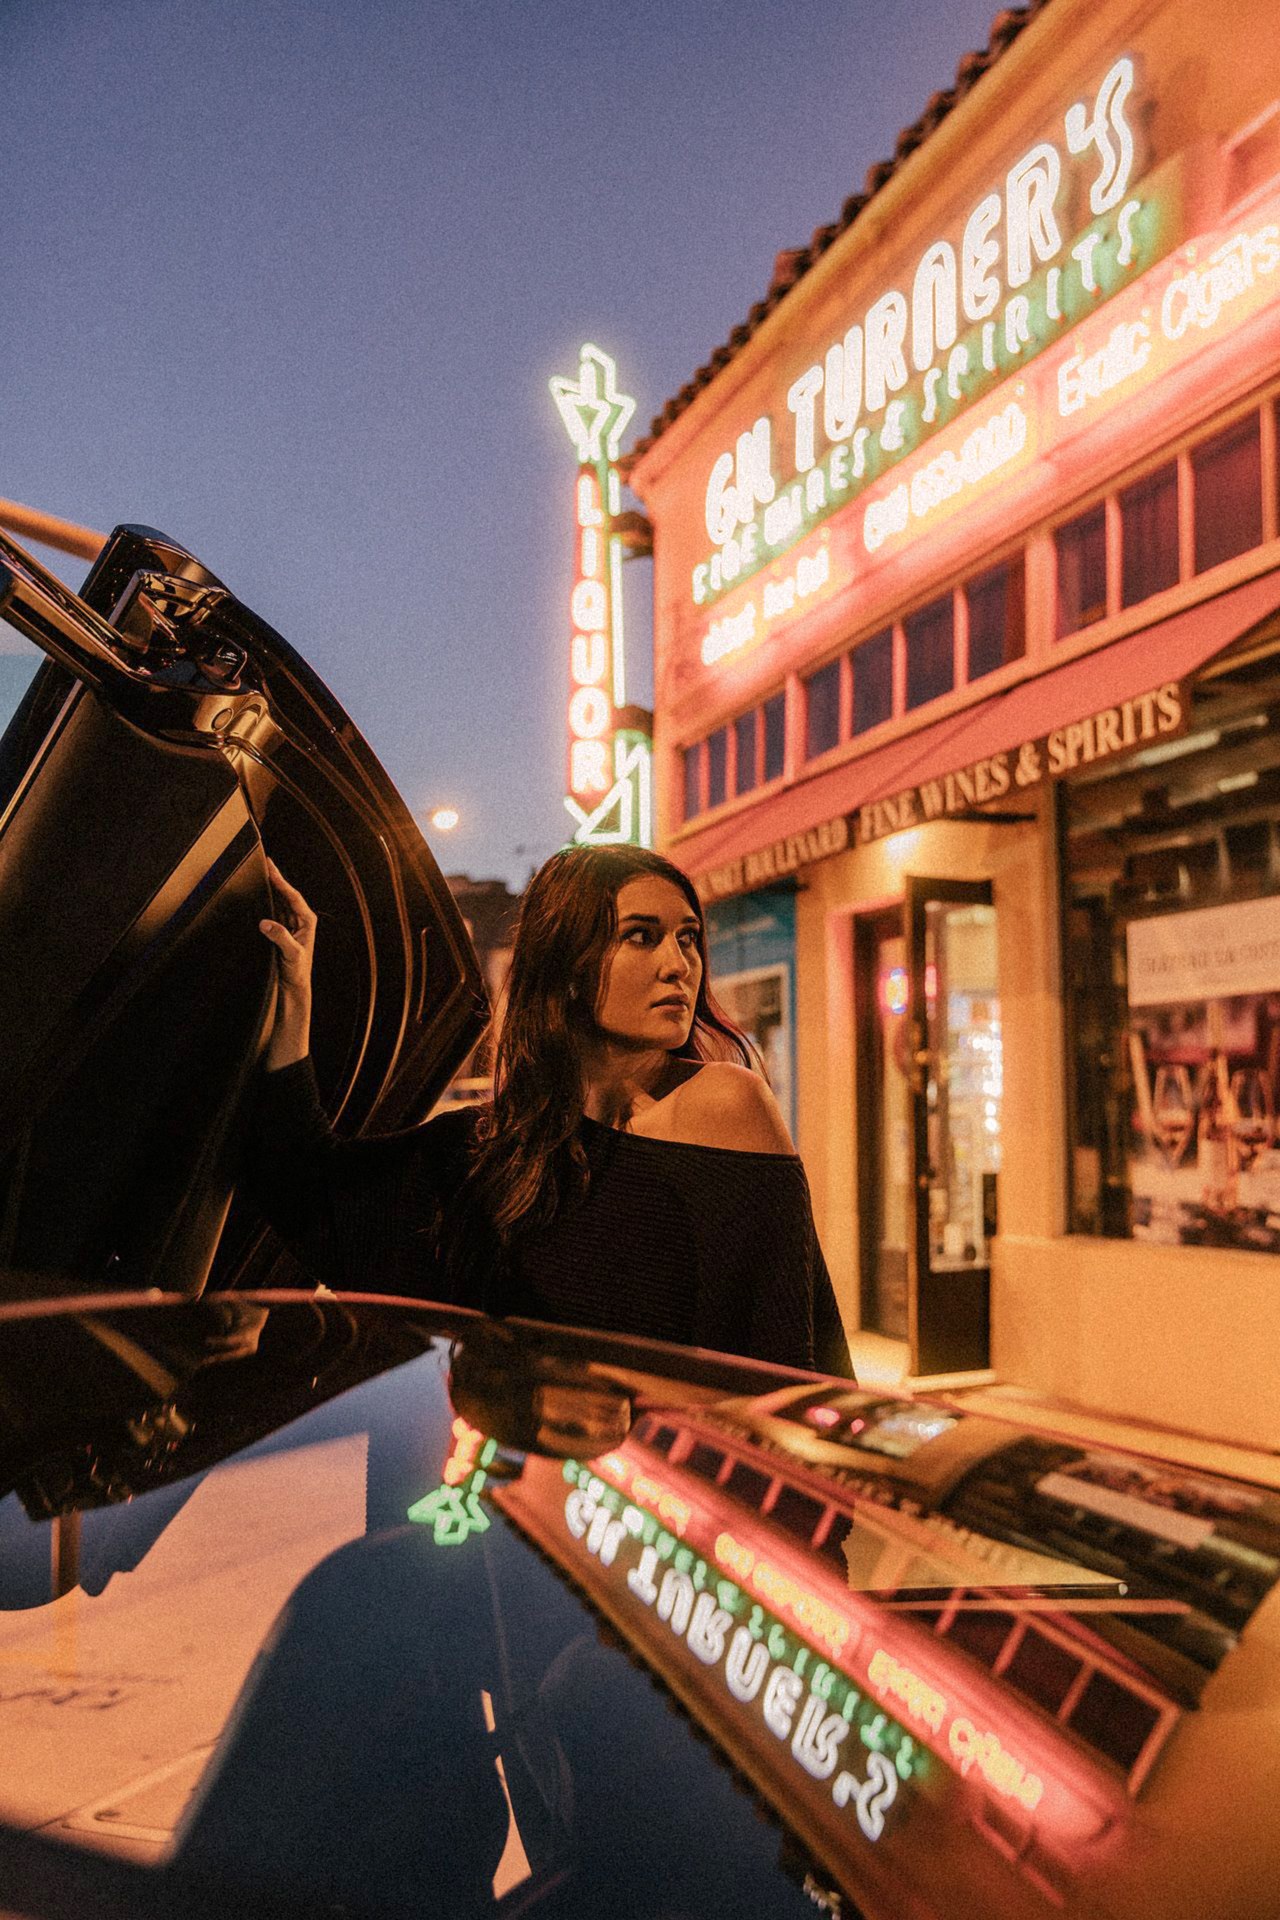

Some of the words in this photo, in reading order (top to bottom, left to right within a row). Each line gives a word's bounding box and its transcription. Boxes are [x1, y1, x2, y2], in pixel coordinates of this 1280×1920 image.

[786, 57, 1135, 473] TURNER'S
[920, 200, 1141, 424] SPIRITS
[569, 474, 613, 794] LIQUOR
[860, 788, 916, 842] FINE
[918, 752, 1011, 820] WINES
[1015, 742, 1042, 786] &
[1047, 682, 1182, 775] SPIRITS
